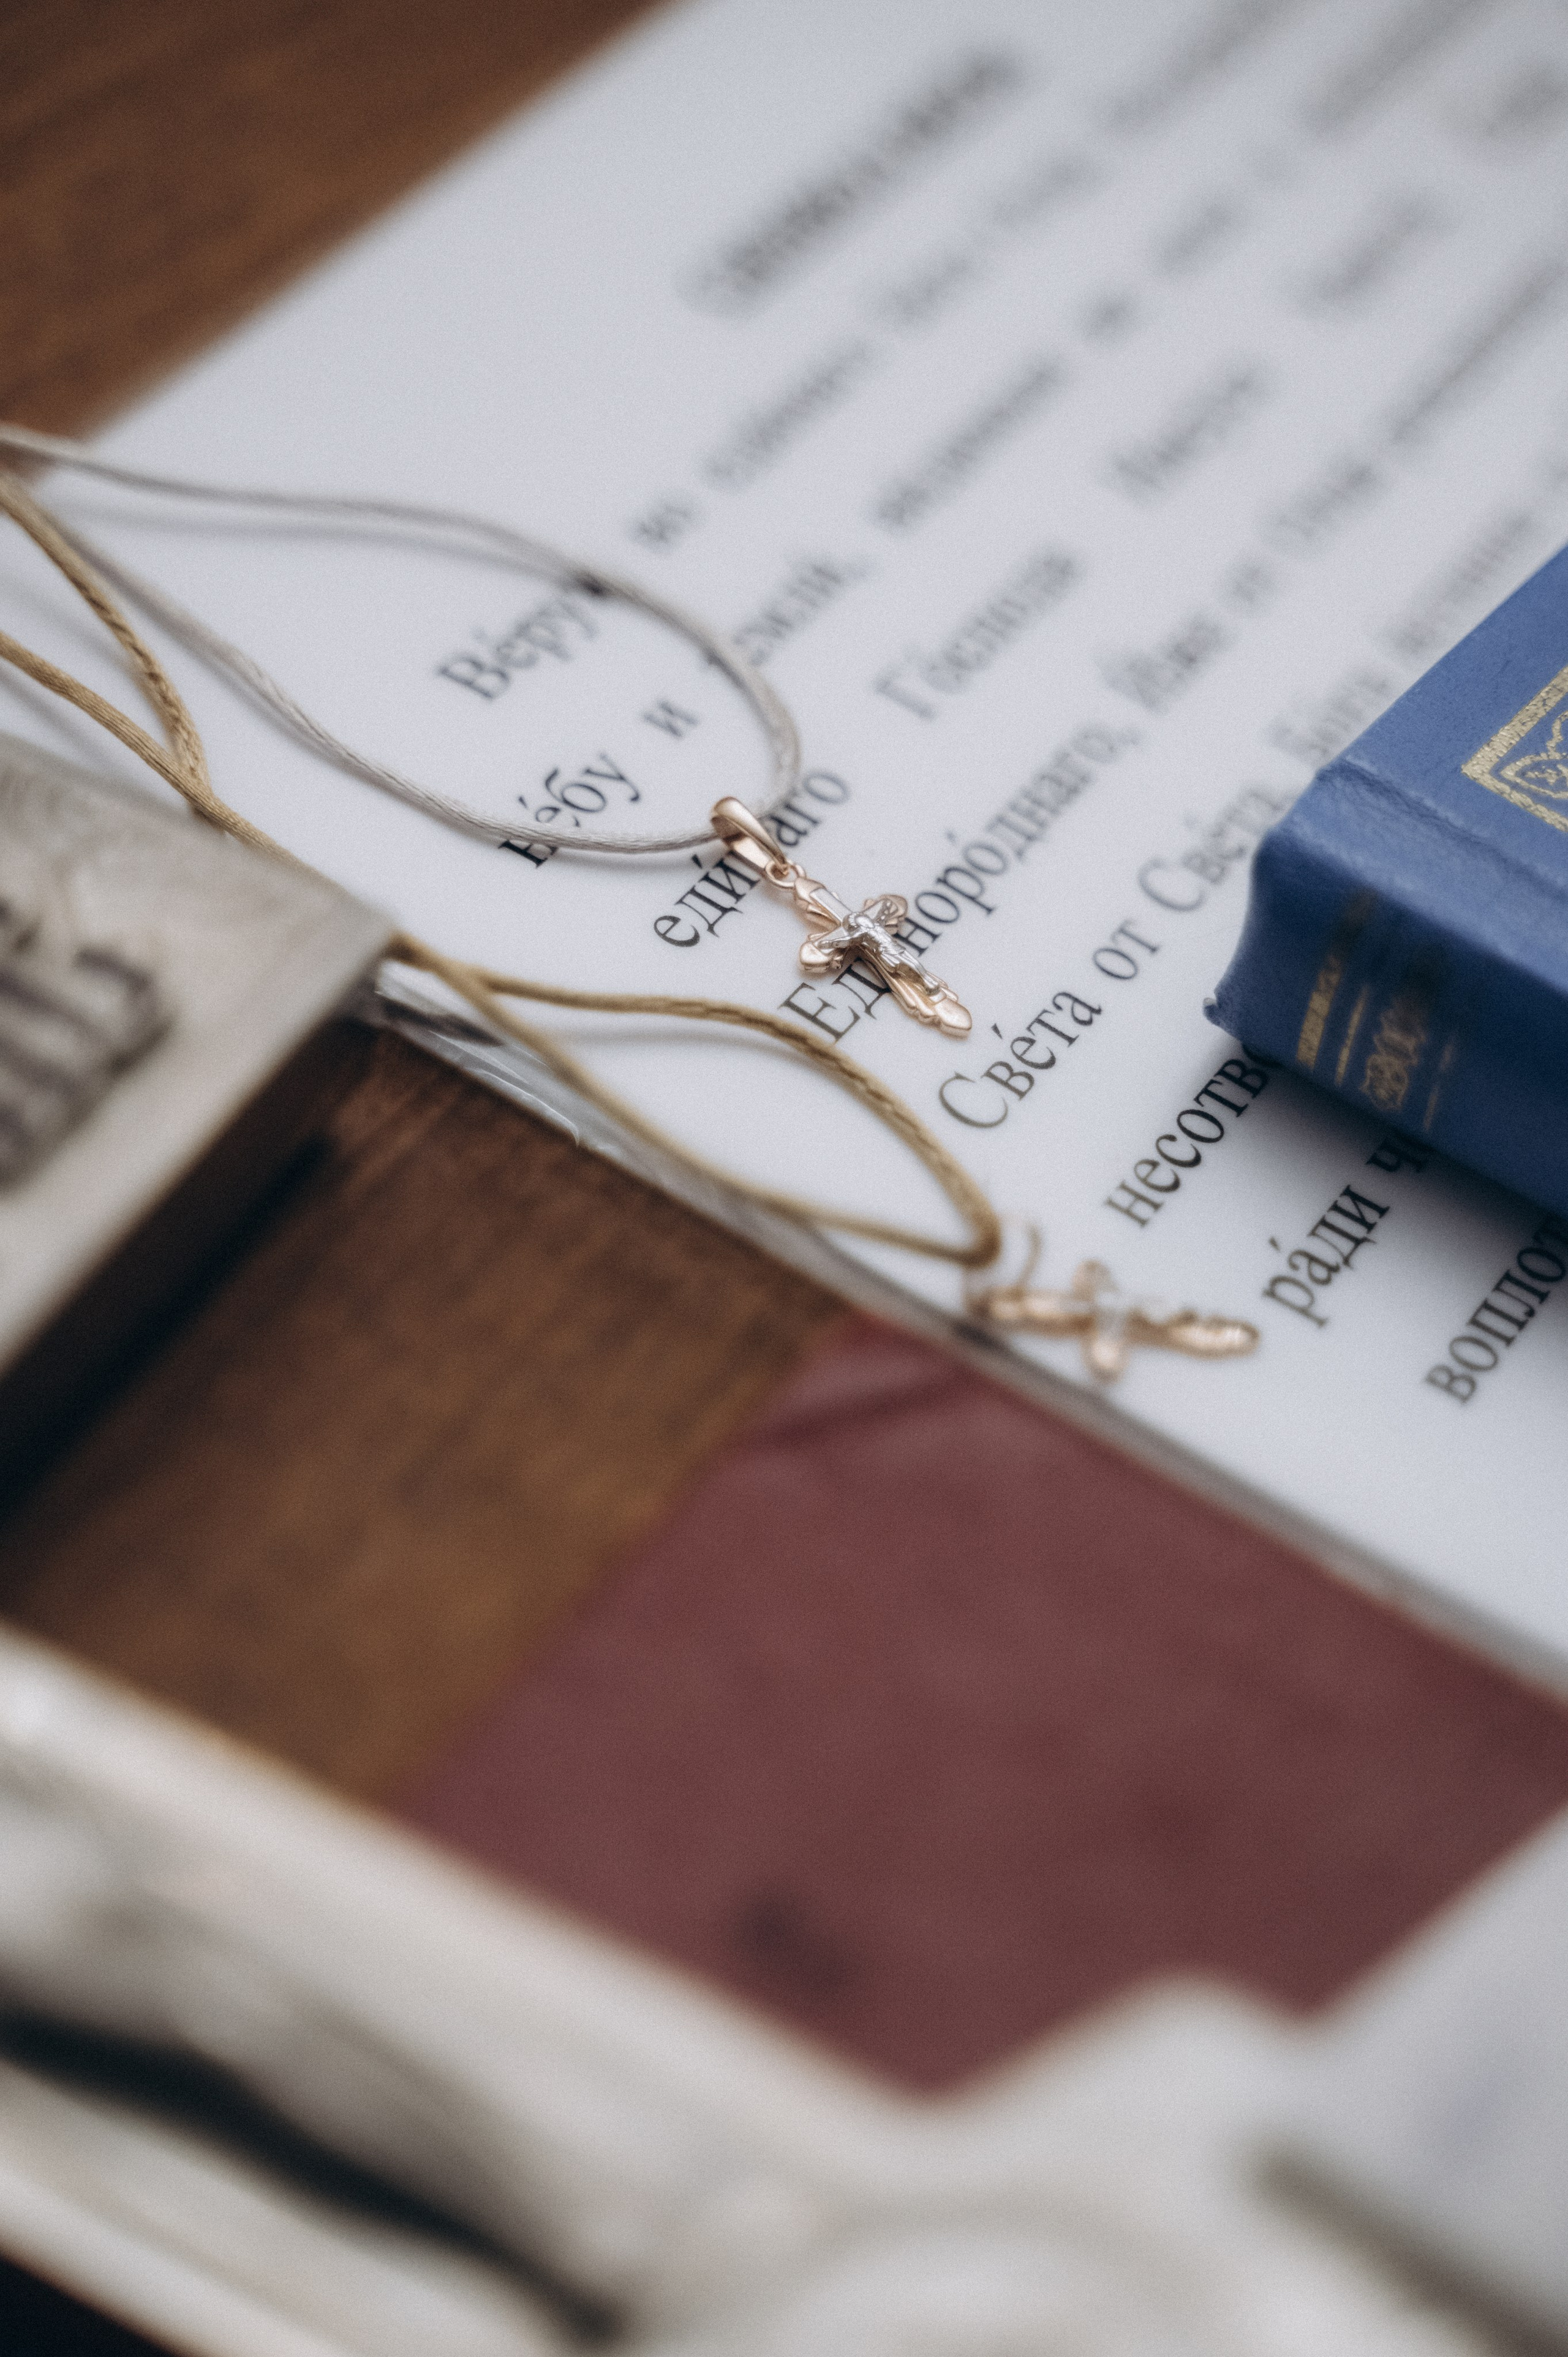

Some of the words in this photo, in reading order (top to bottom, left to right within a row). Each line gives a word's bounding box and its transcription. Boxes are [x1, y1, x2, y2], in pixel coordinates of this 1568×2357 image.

[640, 697, 699, 740] и
[653, 771, 850, 948] еди́аго
[778, 723, 1142, 1043] Едноро́днаго,
[938, 990, 1102, 1128] Све́та
[1092, 919, 1159, 981] от
[1262, 1185, 1390, 1329] ра́ди
